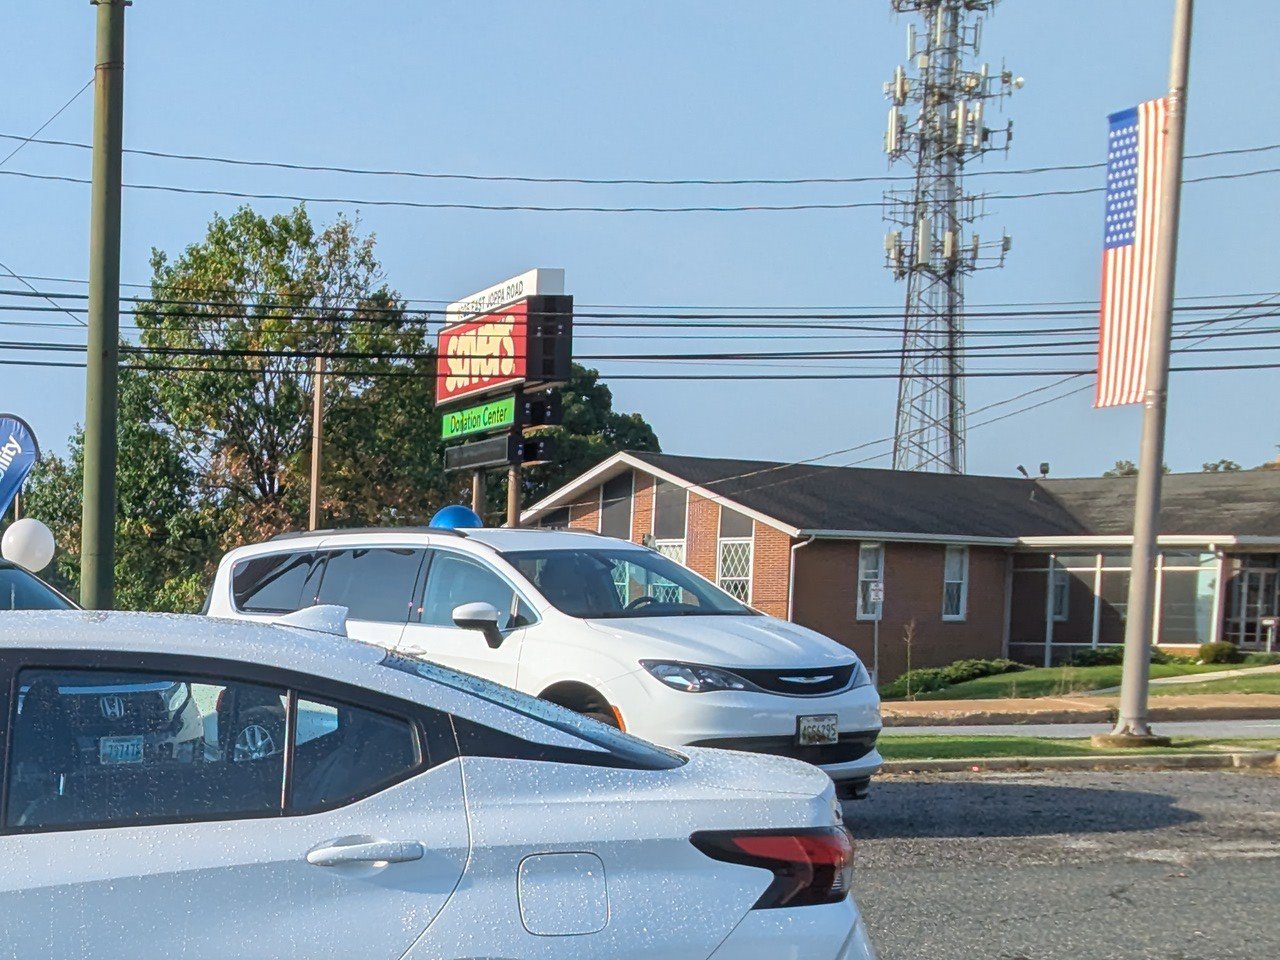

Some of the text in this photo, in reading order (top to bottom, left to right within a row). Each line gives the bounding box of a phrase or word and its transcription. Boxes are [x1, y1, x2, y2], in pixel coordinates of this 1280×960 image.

[486, 287, 505, 308] JOPPA
[506, 279, 524, 299] ROAD
[450, 406, 507, 433] Donation Center
